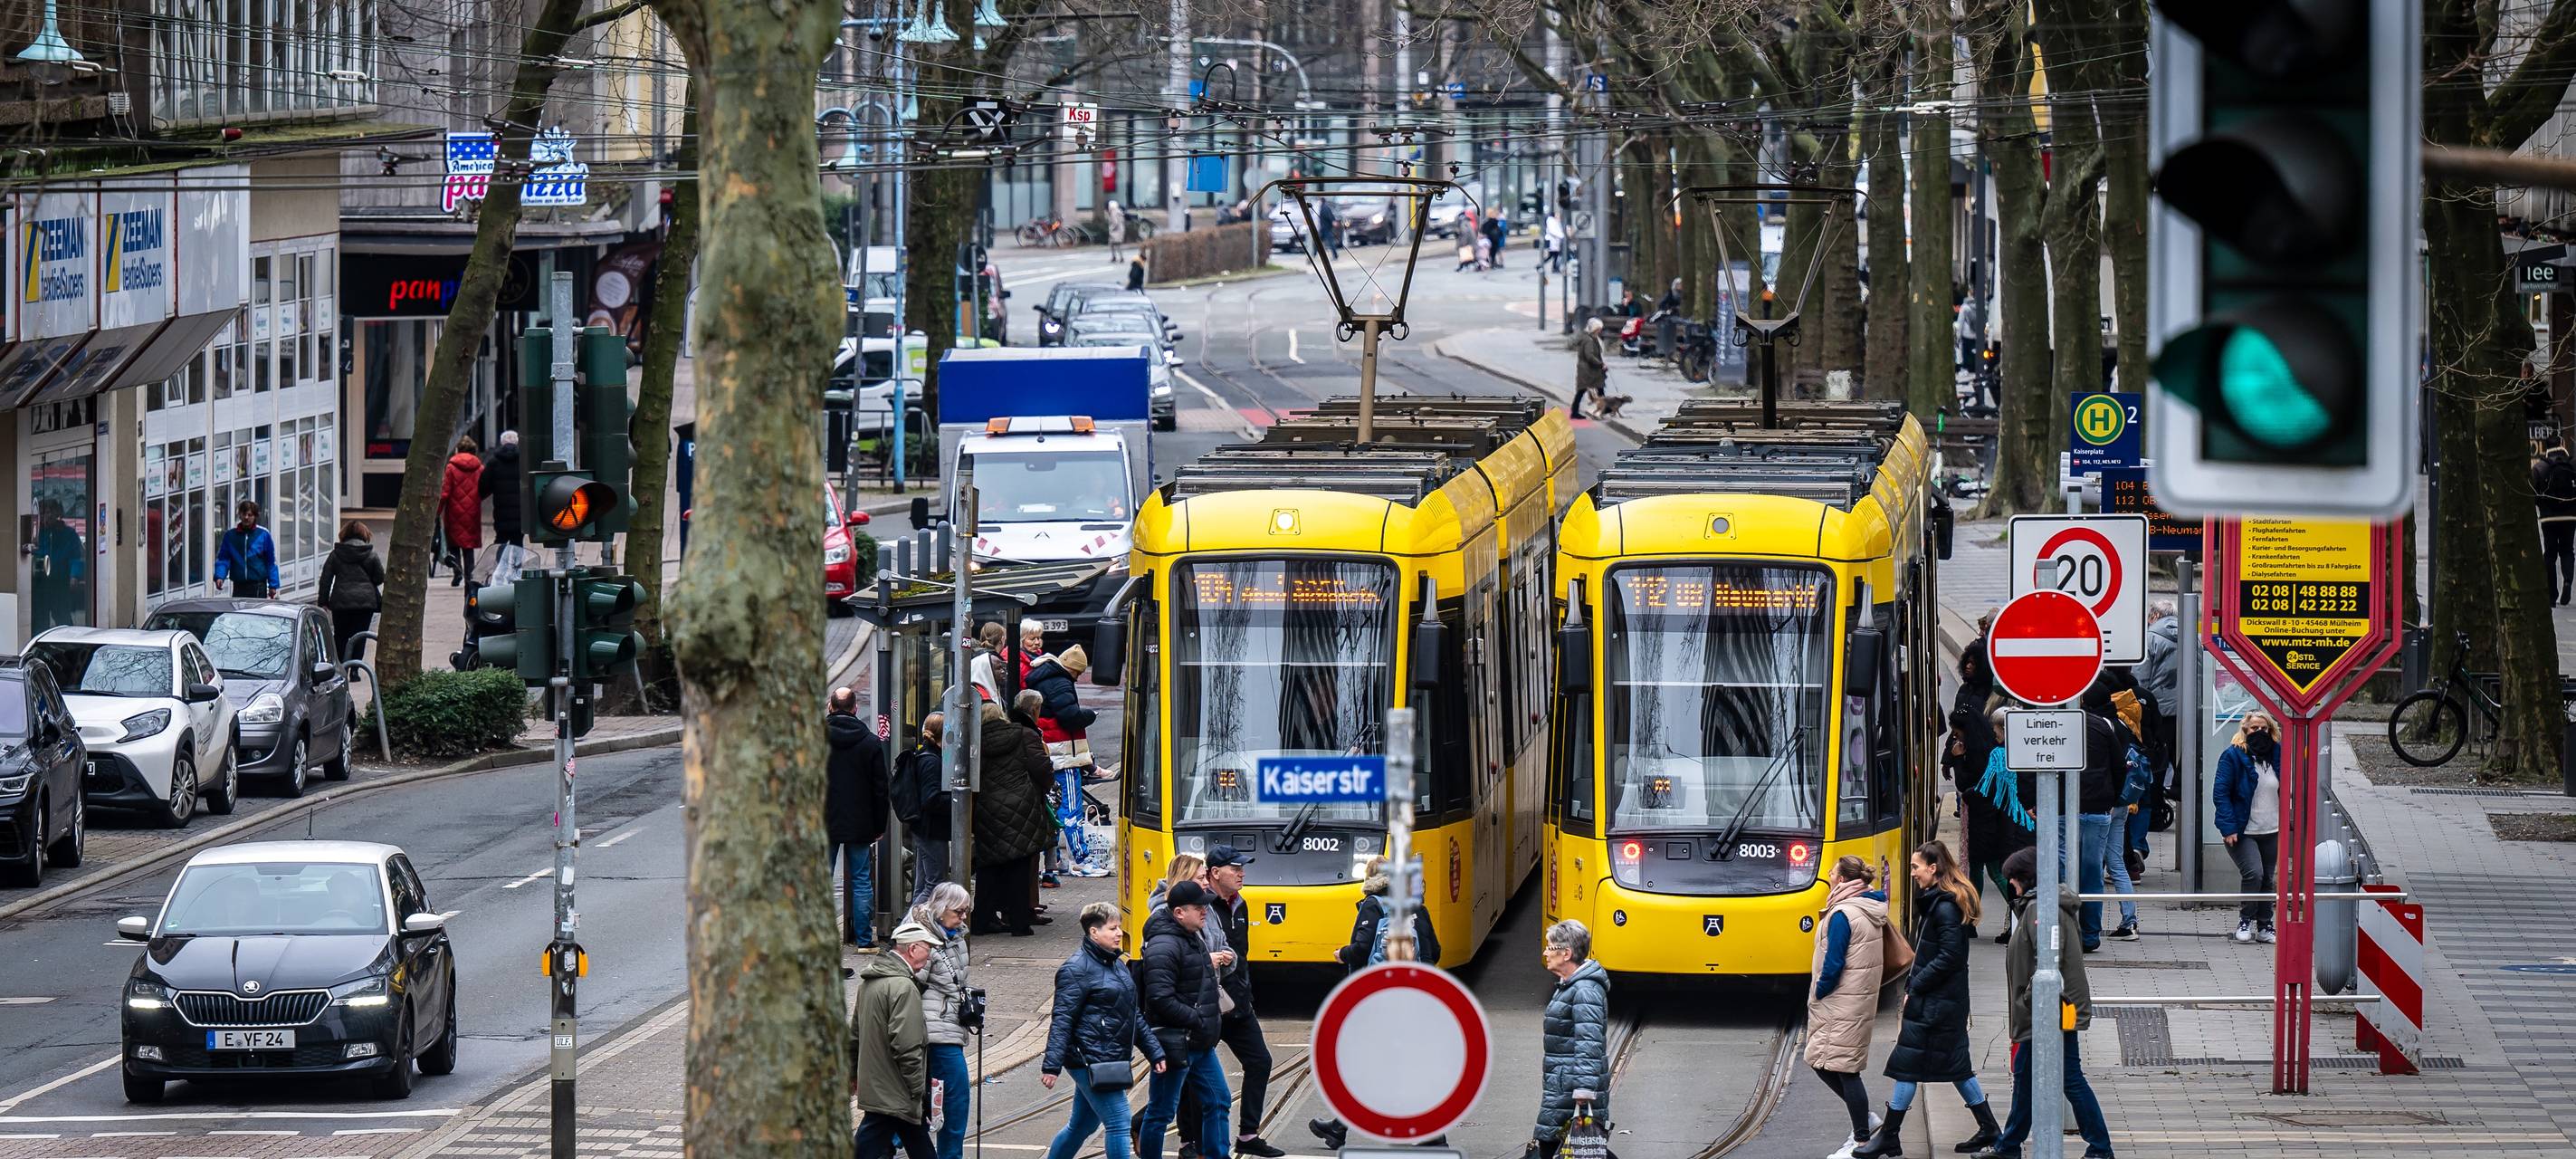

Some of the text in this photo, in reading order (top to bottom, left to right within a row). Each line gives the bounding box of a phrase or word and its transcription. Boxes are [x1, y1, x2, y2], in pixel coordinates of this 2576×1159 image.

[1069, 107, 1091, 123] Ksp
[453, 160, 495, 172] America
[446, 175, 491, 209] pa
[122, 208, 162, 253] ZEEMAN
[41, 217, 84, 262] ZEEMAN
[122, 256, 162, 295] textielSupers
[41, 266, 84, 306] textielSupers
[2127, 406, 2138, 424] 2
[2115, 481, 2135, 491] 104
[2115, 495, 2134, 505] 112
[2149, 526, 2204, 536] B-Neumar
[2056, 554, 2103, 597] 20
[2251, 585, 2357, 598] 02 08 48 88 88
[2251, 599, 2357, 611] 02 08 42 22 22
[1051, 621, 1067, 630] 393
[2264, 627, 2324, 636] Online-Buchung
[2261, 637, 2350, 647] www.mtz-mh.de
[2026, 718, 2064, 729] Linien-
[2023, 735, 2067, 746] verkehr
[2036, 752, 2056, 762] frei
[1302, 837, 1340, 852] 8002
[1739, 843, 1776, 858] 8003
[224, 1032, 234, 1047] E
[243, 1032, 262, 1047] YF
[265, 1032, 283, 1047] 24
